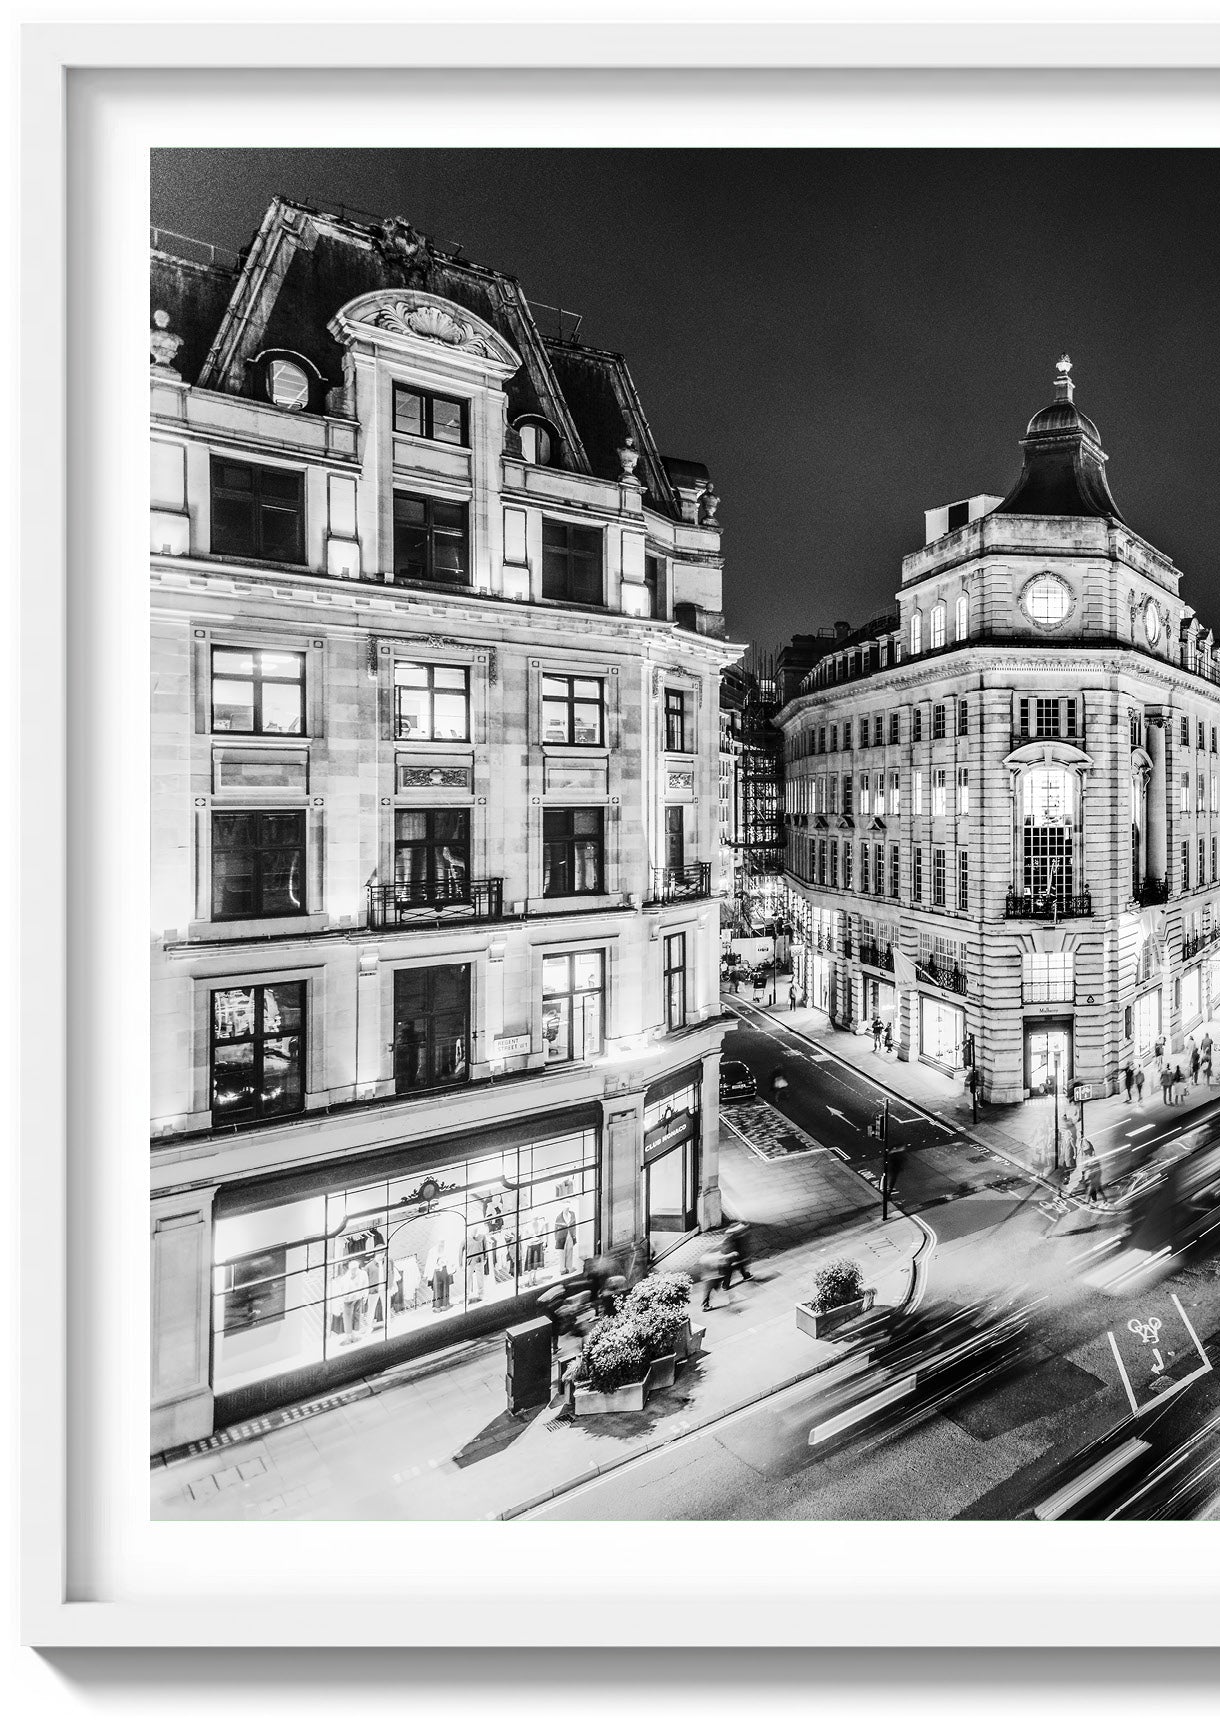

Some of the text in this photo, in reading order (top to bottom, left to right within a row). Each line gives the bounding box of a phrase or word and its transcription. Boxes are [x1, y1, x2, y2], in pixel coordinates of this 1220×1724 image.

[498, 1038, 518, 1047] REGENT
[498, 1043, 518, 1051] STREET
[645, 1124, 687, 1152] CLUB MONACO
